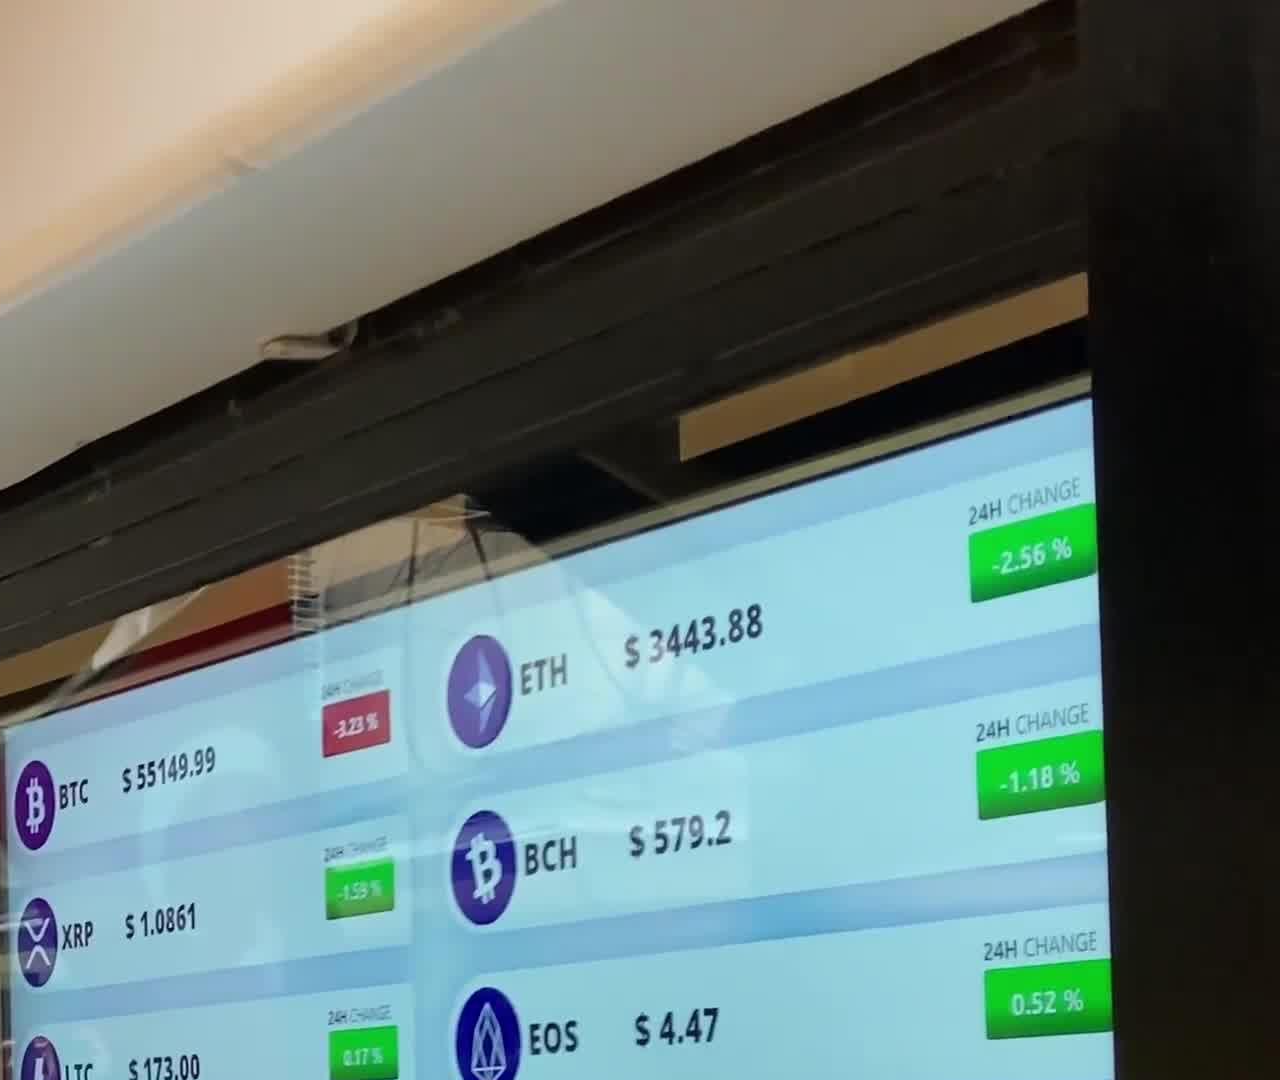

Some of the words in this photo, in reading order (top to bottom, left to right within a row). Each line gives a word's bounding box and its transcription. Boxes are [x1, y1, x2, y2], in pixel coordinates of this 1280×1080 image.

[968, 500, 1002, 525] 24H
[1007, 477, 1081, 515] CHANGE
[992, 543, 1044, 575] -2.56
[1051, 536, 1073, 560] %
[520, 654, 567, 695] ETH
[649, 604, 762, 663] 3443.88
[976, 718, 1010, 743] 24H
[1016, 702, 1090, 735] CHANGE
[58, 778, 89, 811] BTC
[136, 746, 216, 790] 55149.99
[1000, 766, 1052, 793] -1.18
[1060, 761, 1080, 784] %
[525, 836, 576, 876] BCH
[655, 810, 731, 855] 579.2
[62, 920, 94, 951] XRP
[140, 903, 197, 938] 1.0861
[983, 940, 1018, 961] 24H
[1023, 932, 1097, 958] CHANGE
[1011, 990, 1057, 1017] 0.52
[1063, 988, 1084, 1012] %
[529, 1021, 578, 1055] EOS
[660, 1008, 719, 1045] 4.47
